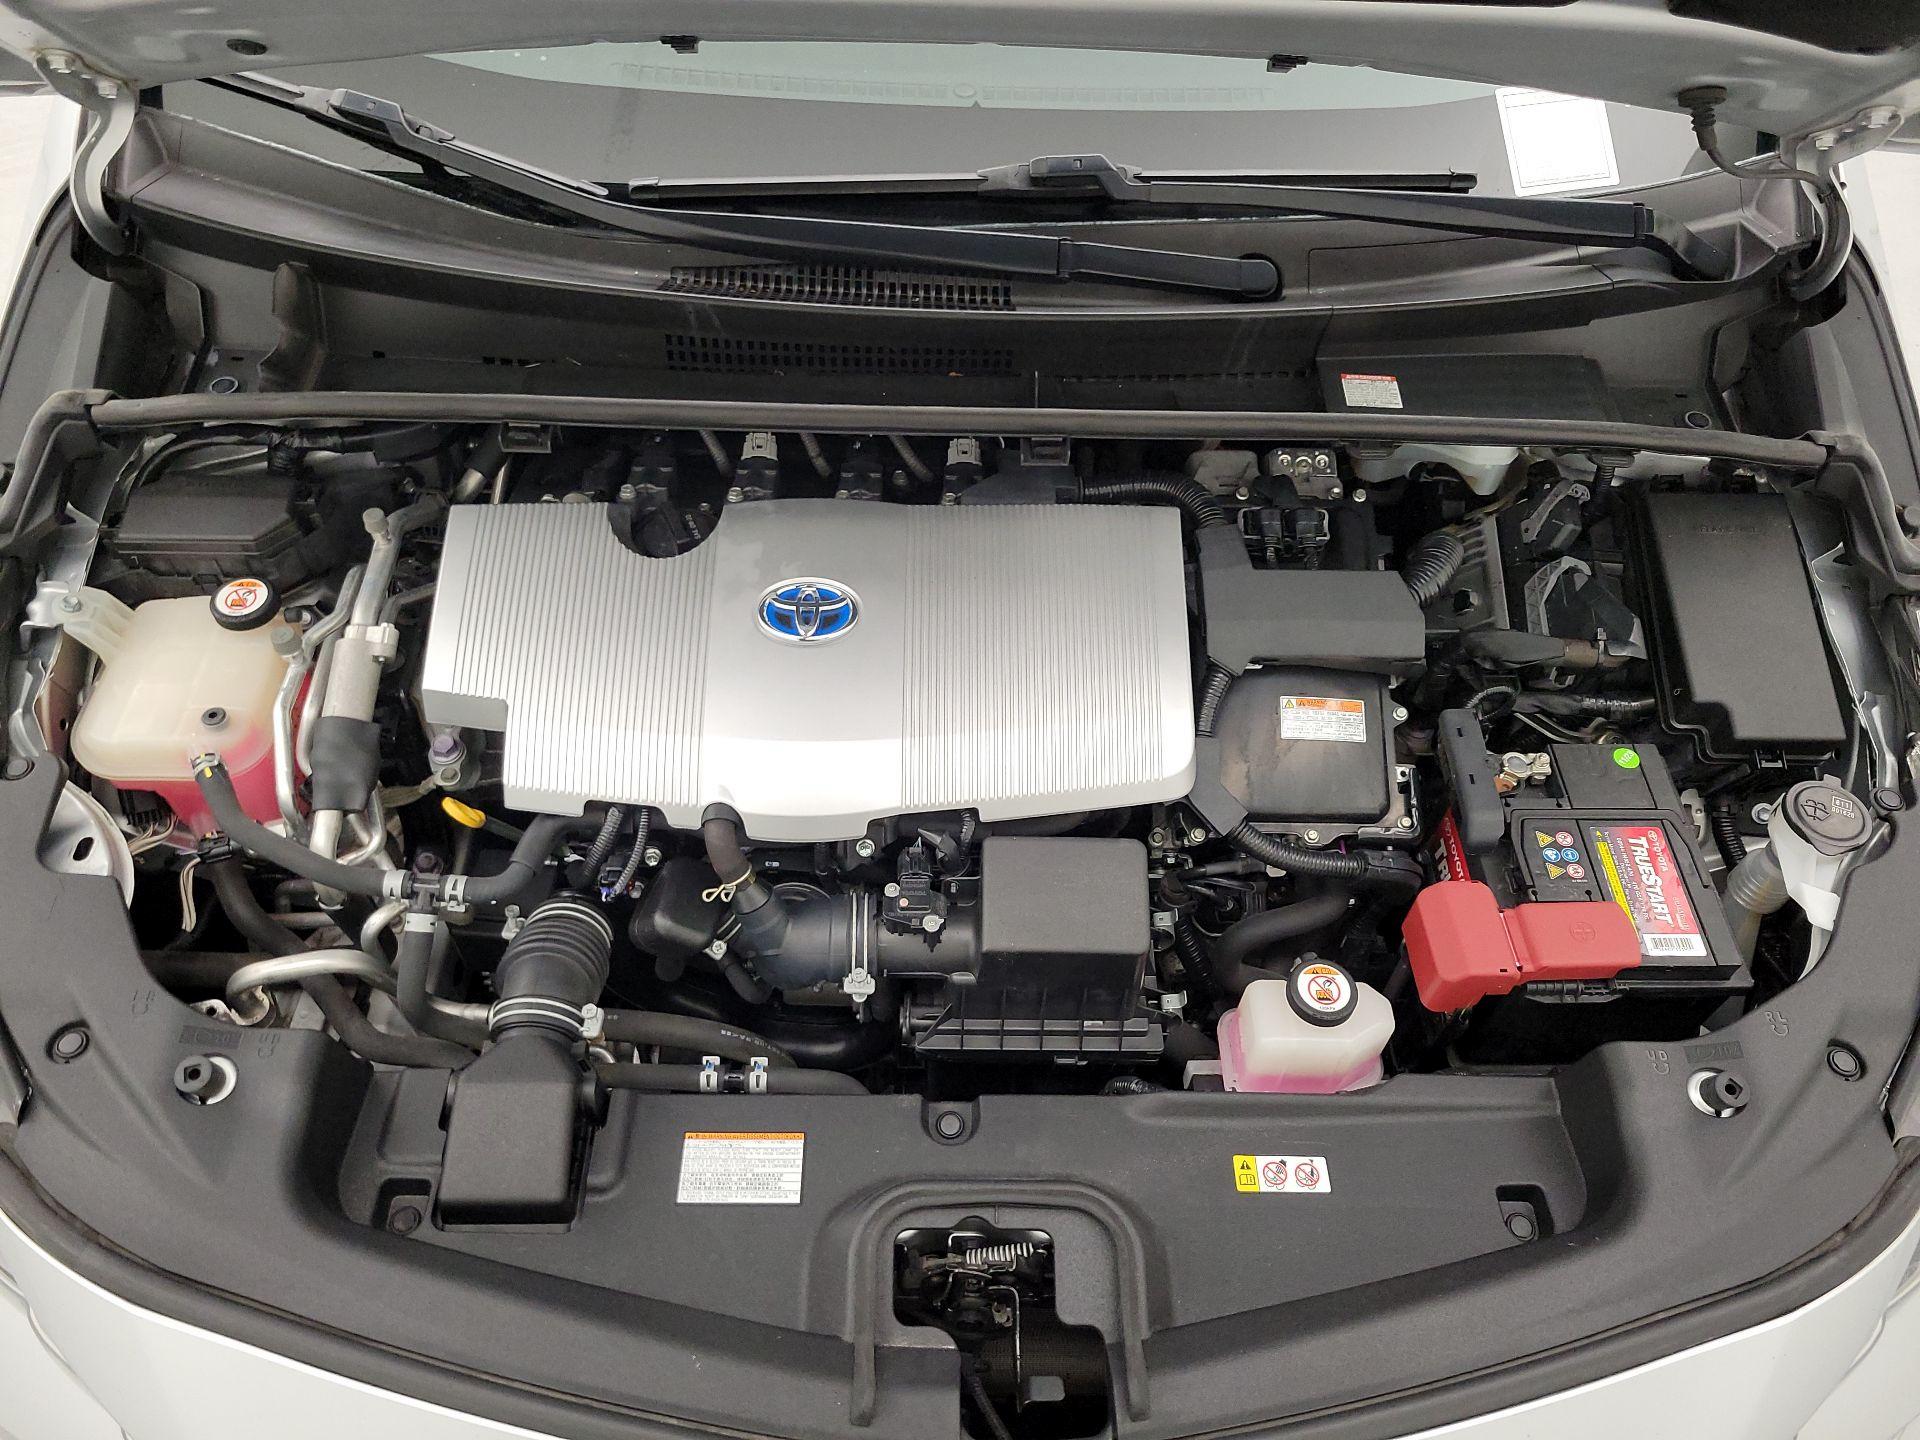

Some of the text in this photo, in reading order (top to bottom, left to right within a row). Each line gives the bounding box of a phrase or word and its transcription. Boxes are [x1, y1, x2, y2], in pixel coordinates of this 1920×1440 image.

[1449, 836, 1466, 881] TOYOT
[1653, 841, 1669, 872] TOYOTA
[1628, 836, 1674, 926] TRUESTART
